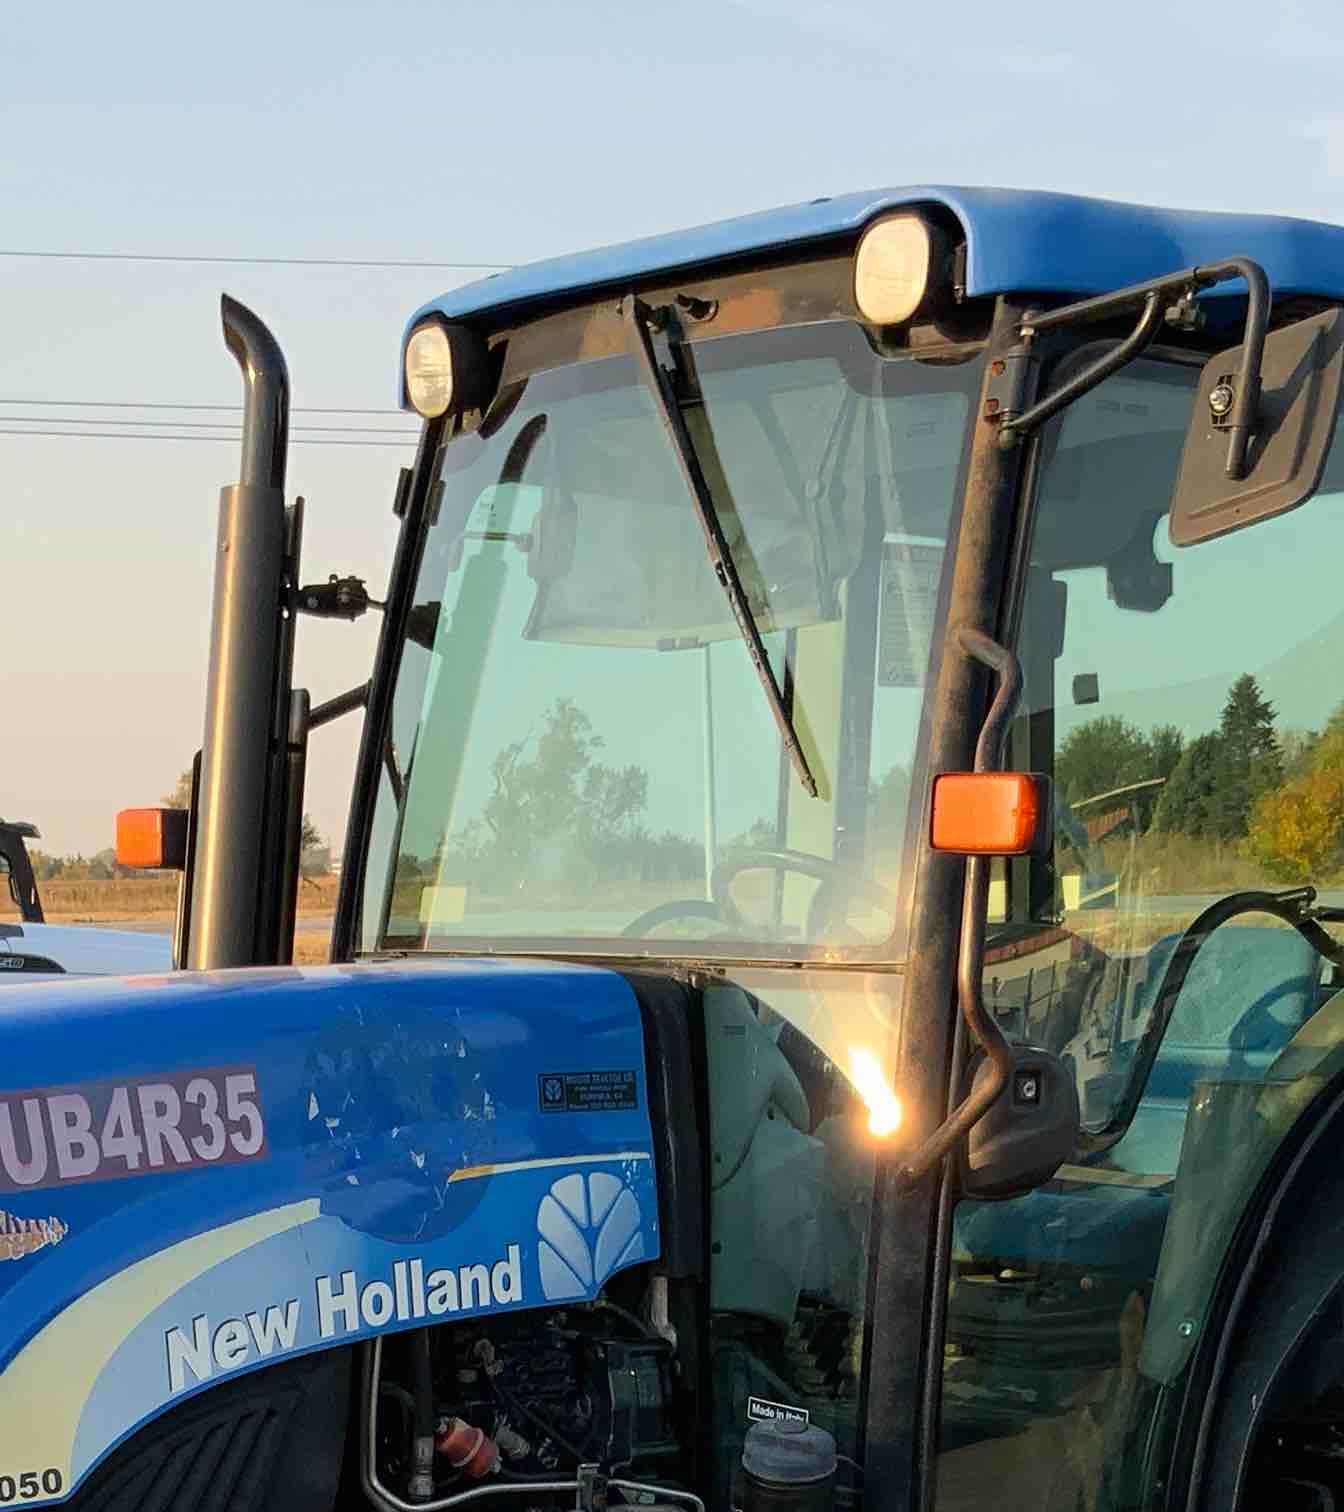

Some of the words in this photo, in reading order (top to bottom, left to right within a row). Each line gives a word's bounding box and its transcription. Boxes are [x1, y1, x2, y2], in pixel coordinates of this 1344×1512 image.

[163, 1300, 300, 1393] New
[315, 1243, 523, 1337] Holland
[752, 1403, 775, 1418] Made
